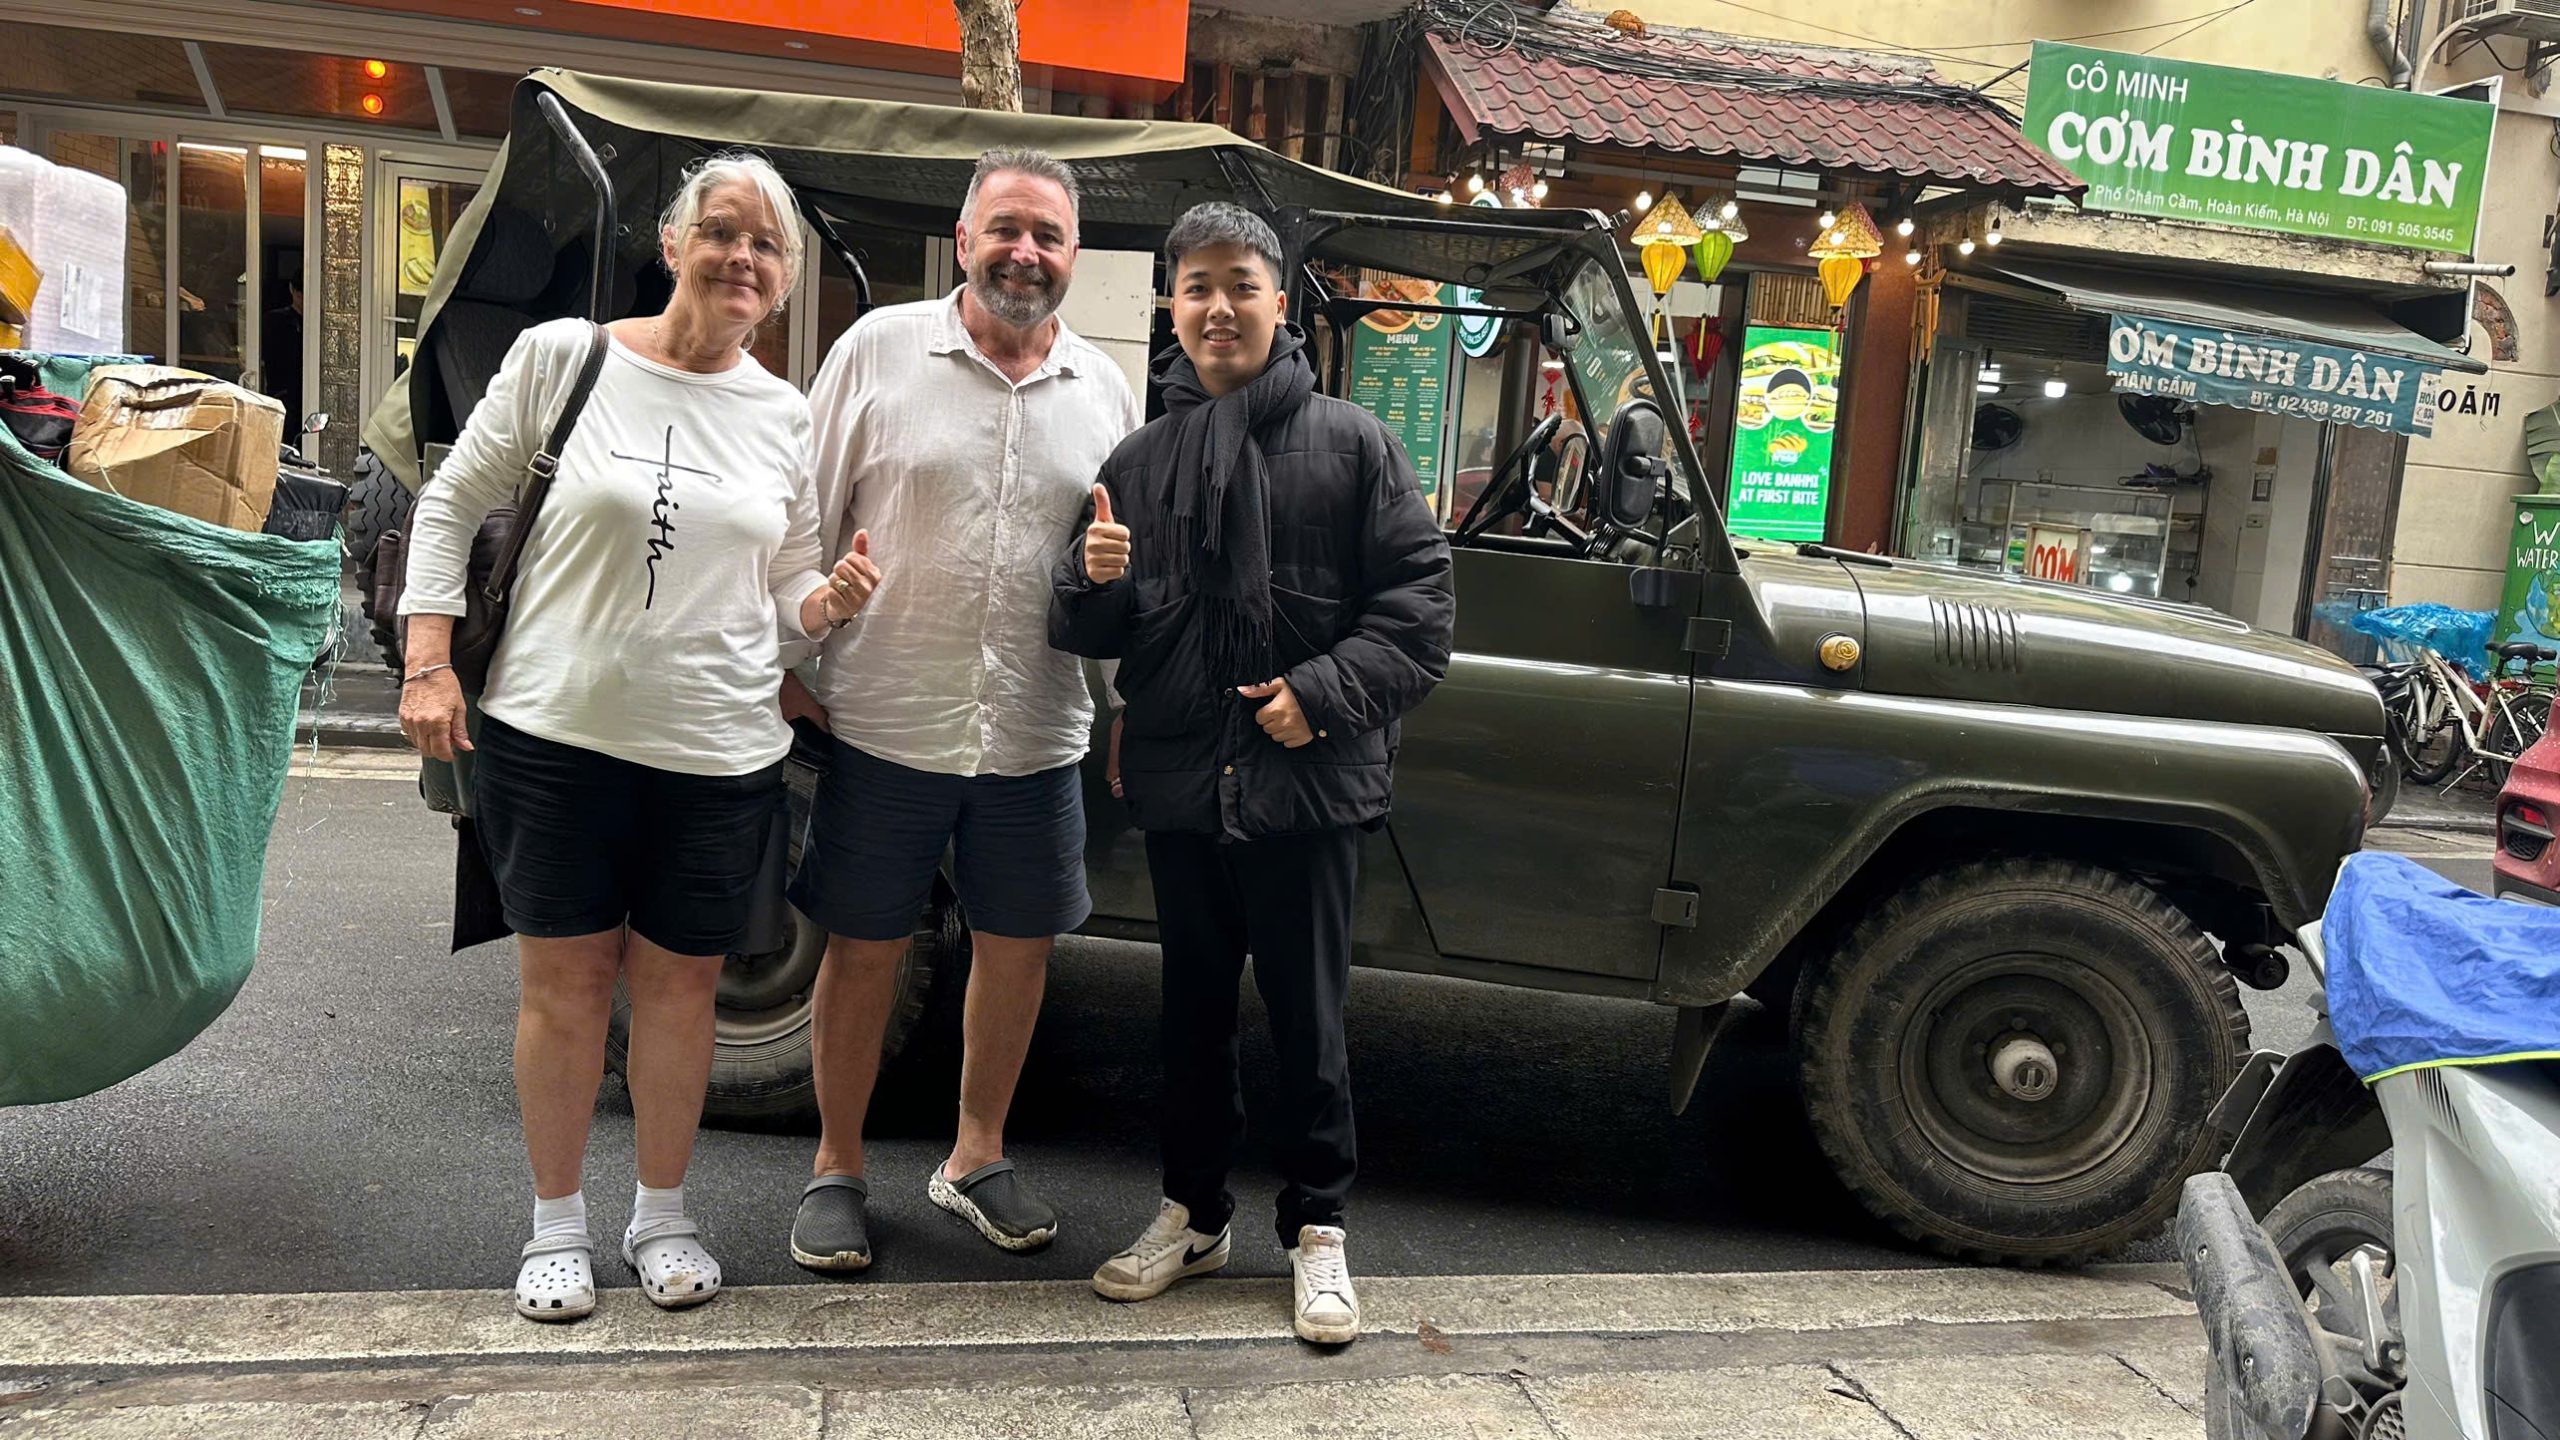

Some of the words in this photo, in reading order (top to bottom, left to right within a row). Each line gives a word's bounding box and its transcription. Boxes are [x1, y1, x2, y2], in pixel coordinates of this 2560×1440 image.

[2066, 59, 2109, 93] CÔ
[2115, 69, 2189, 104] MINH
[2047, 108, 2175, 173] CƠM
[2184, 118, 2330, 192] BÌNH
[2337, 140, 2463, 210] DÂN
[2094, 184, 2124, 203] Phố
[2206, 197, 2242, 216] Hoàn
[2244, 202, 2282, 223] Kiếm,
[2285, 207, 2304, 223] Hà
[2307, 209, 2330, 228] Nội
[2346, 215, 2369, 232] ĐT:
[2371, 218, 2393, 235] 091
[2397, 222, 2421, 238] 505
[2423, 225, 2455, 242] 3545
[1386, 333, 1420, 344] MENU
[2186, 331, 2301, 387] BÌNH
[2307, 352, 2405, 405] DÂN
[2250, 390, 2274, 408] ĐT:
[2277, 394, 2330, 416] 02438
[2332, 404, 2363, 422] 287
[2364, 409, 2394, 427] 261
[1738, 487, 1756, 502] AT
[1756, 488, 1791, 504] FIRST
[1791, 490, 1820, 506] BITE
[1741, 471, 1773, 487] LOVE
[1774, 473, 1820, 489] BANHMI
[2031, 538, 2079, 583] CƠM
[2516, 546, 2560, 570] WATER
